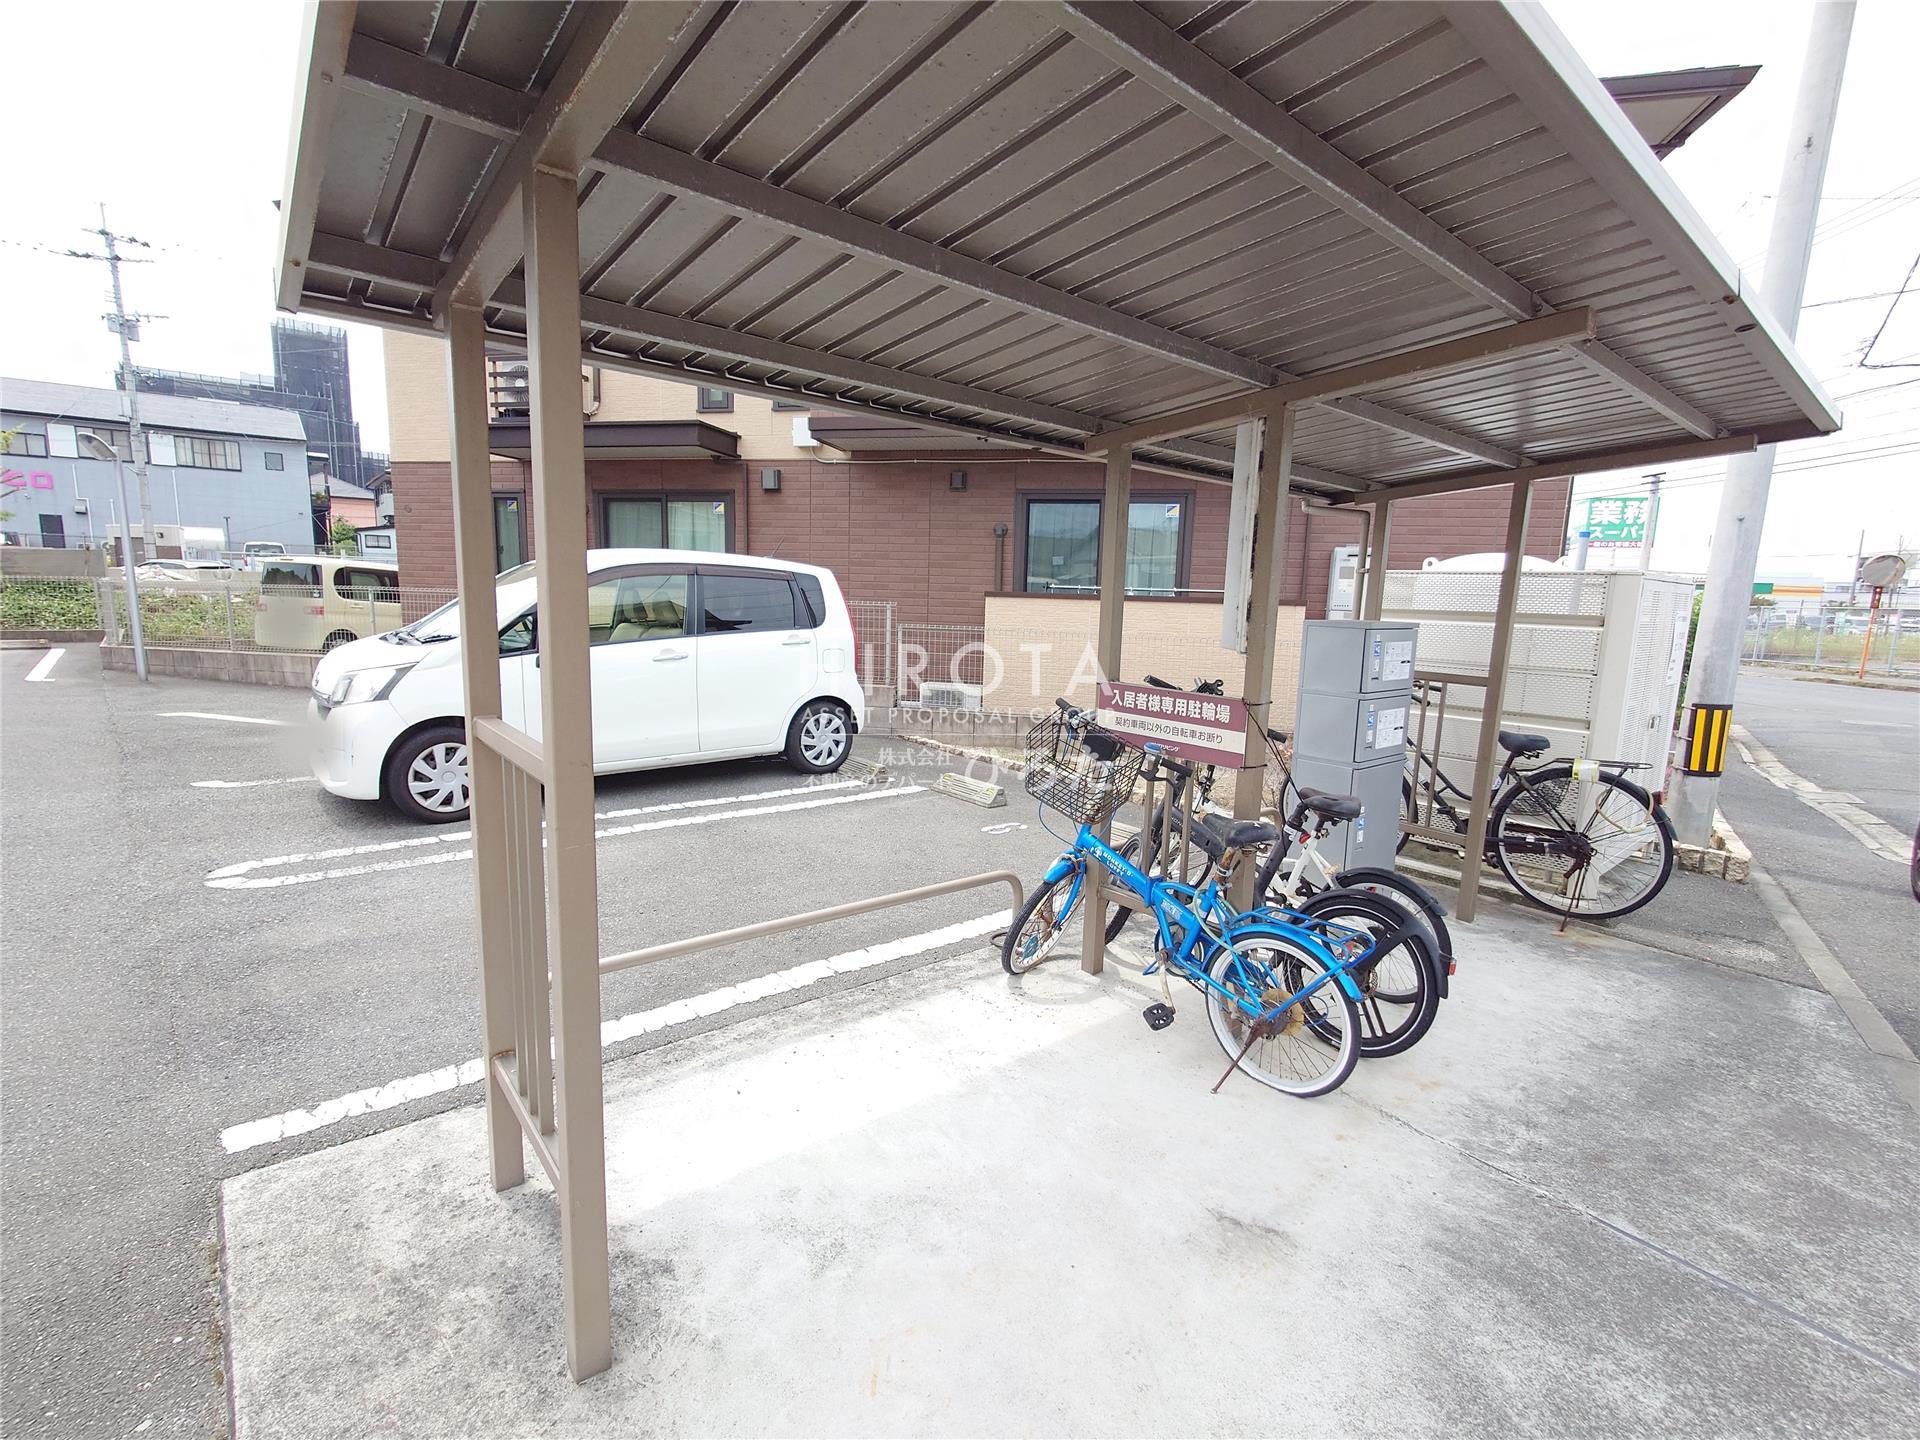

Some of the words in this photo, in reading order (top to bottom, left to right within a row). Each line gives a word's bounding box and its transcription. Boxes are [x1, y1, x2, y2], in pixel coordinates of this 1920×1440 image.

[1111, 689, 1231, 724] 入居者様専用駐輪場
[1114, 716, 1224, 744] 契約車両以外の自転車お断り
